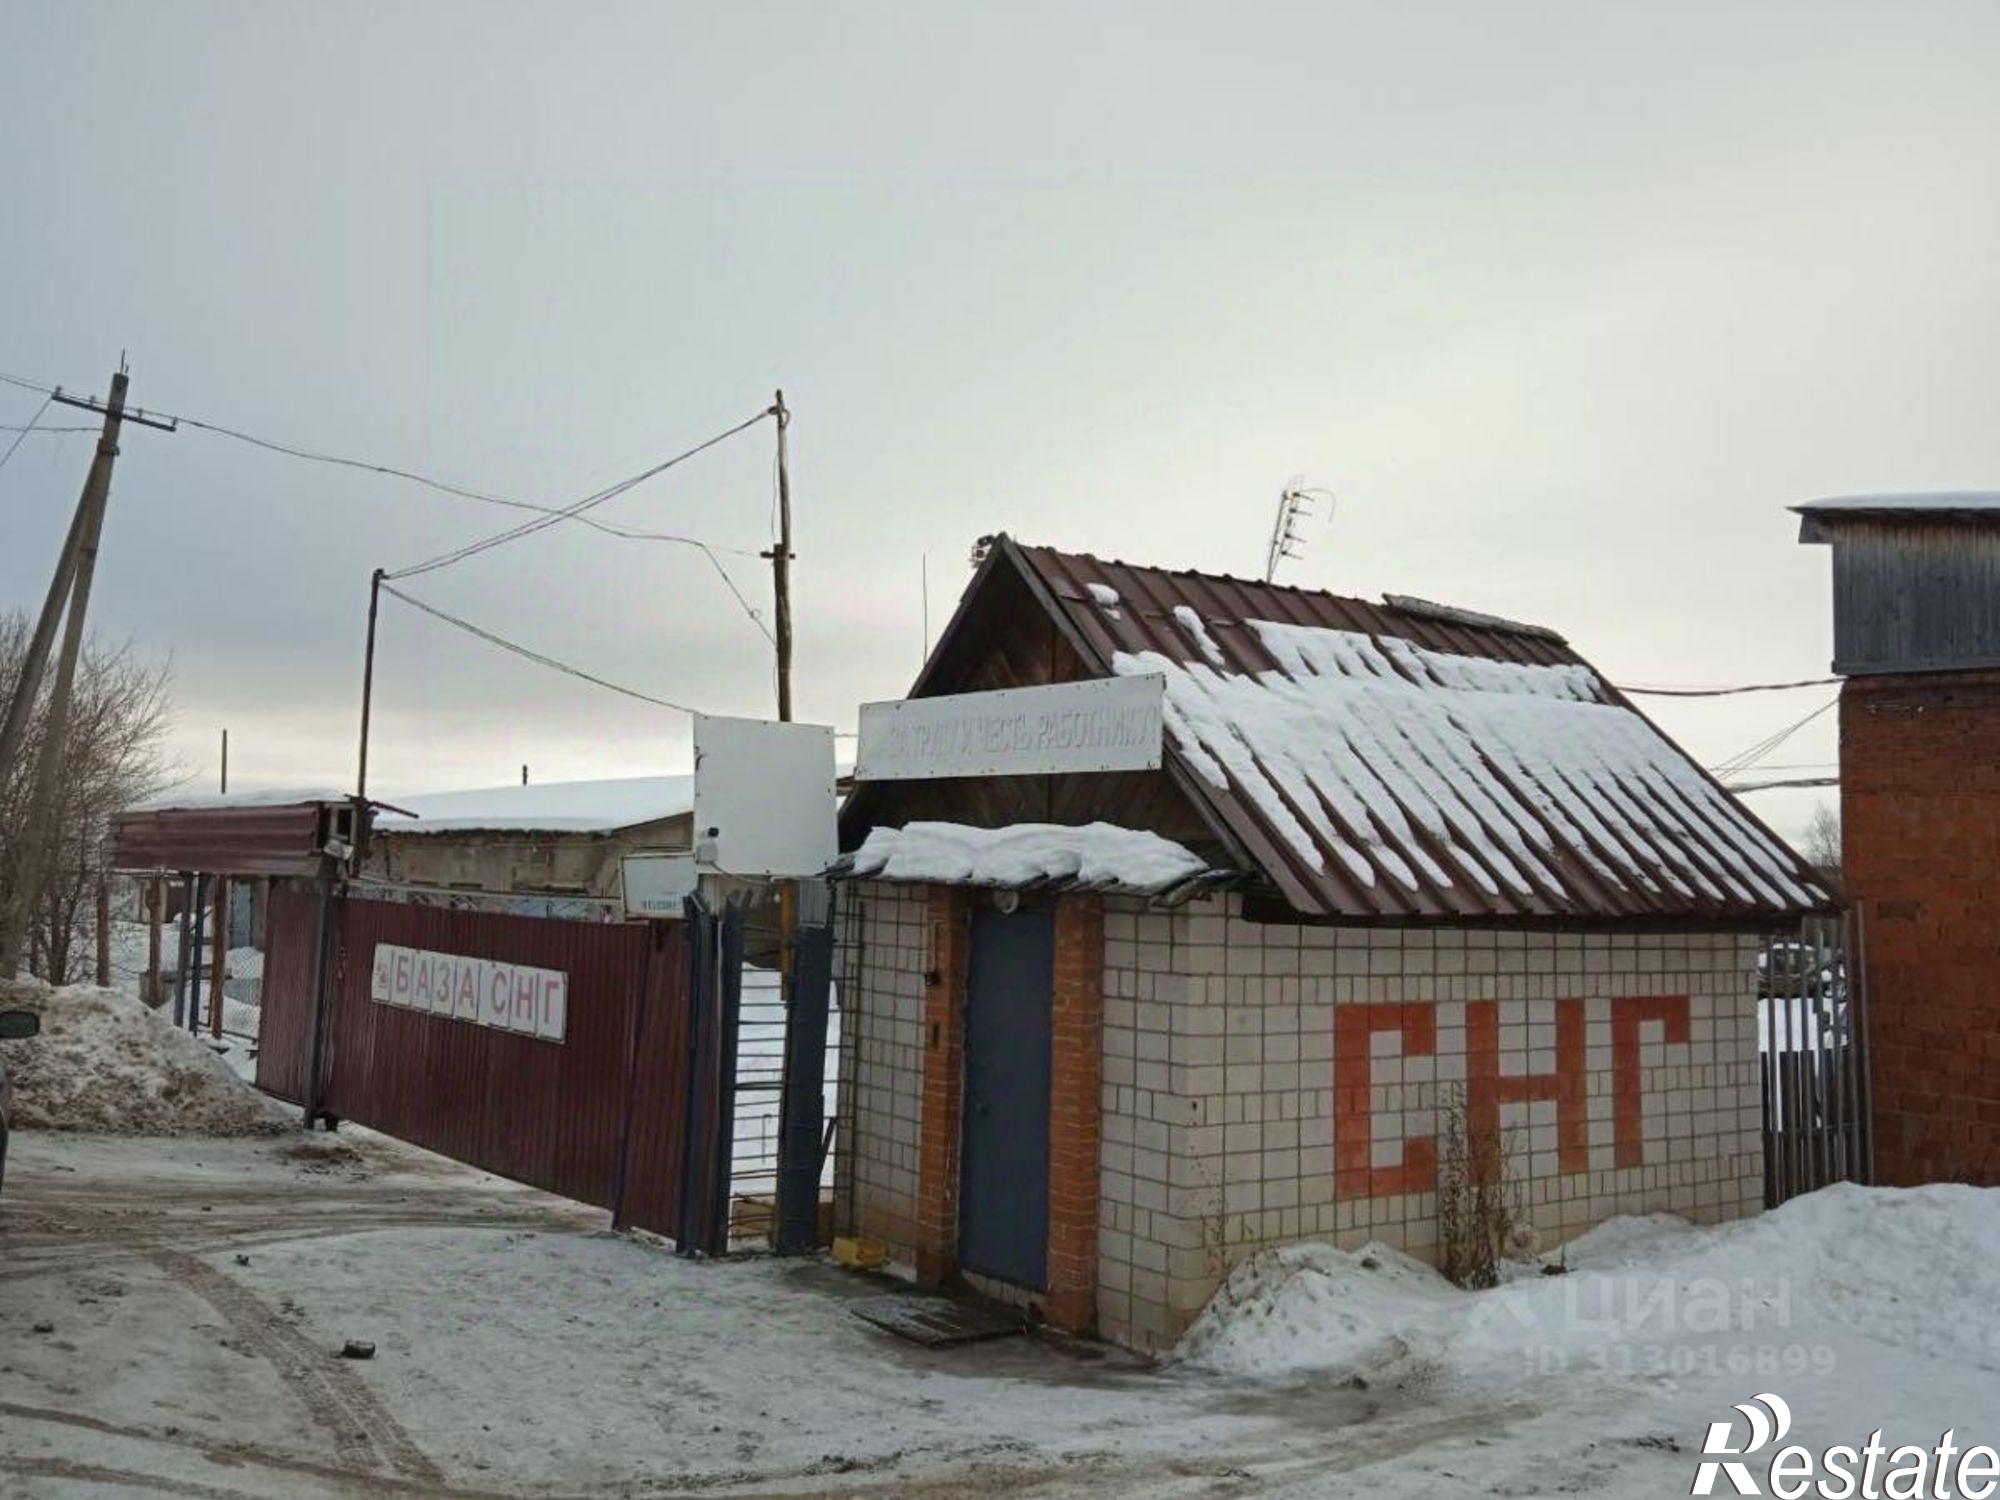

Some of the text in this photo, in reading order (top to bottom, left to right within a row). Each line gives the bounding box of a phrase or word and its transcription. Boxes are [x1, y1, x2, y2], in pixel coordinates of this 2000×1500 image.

[394, 953, 560, 1025] БАЗА СНГ
[1334, 994, 1691, 1200] СНГ
